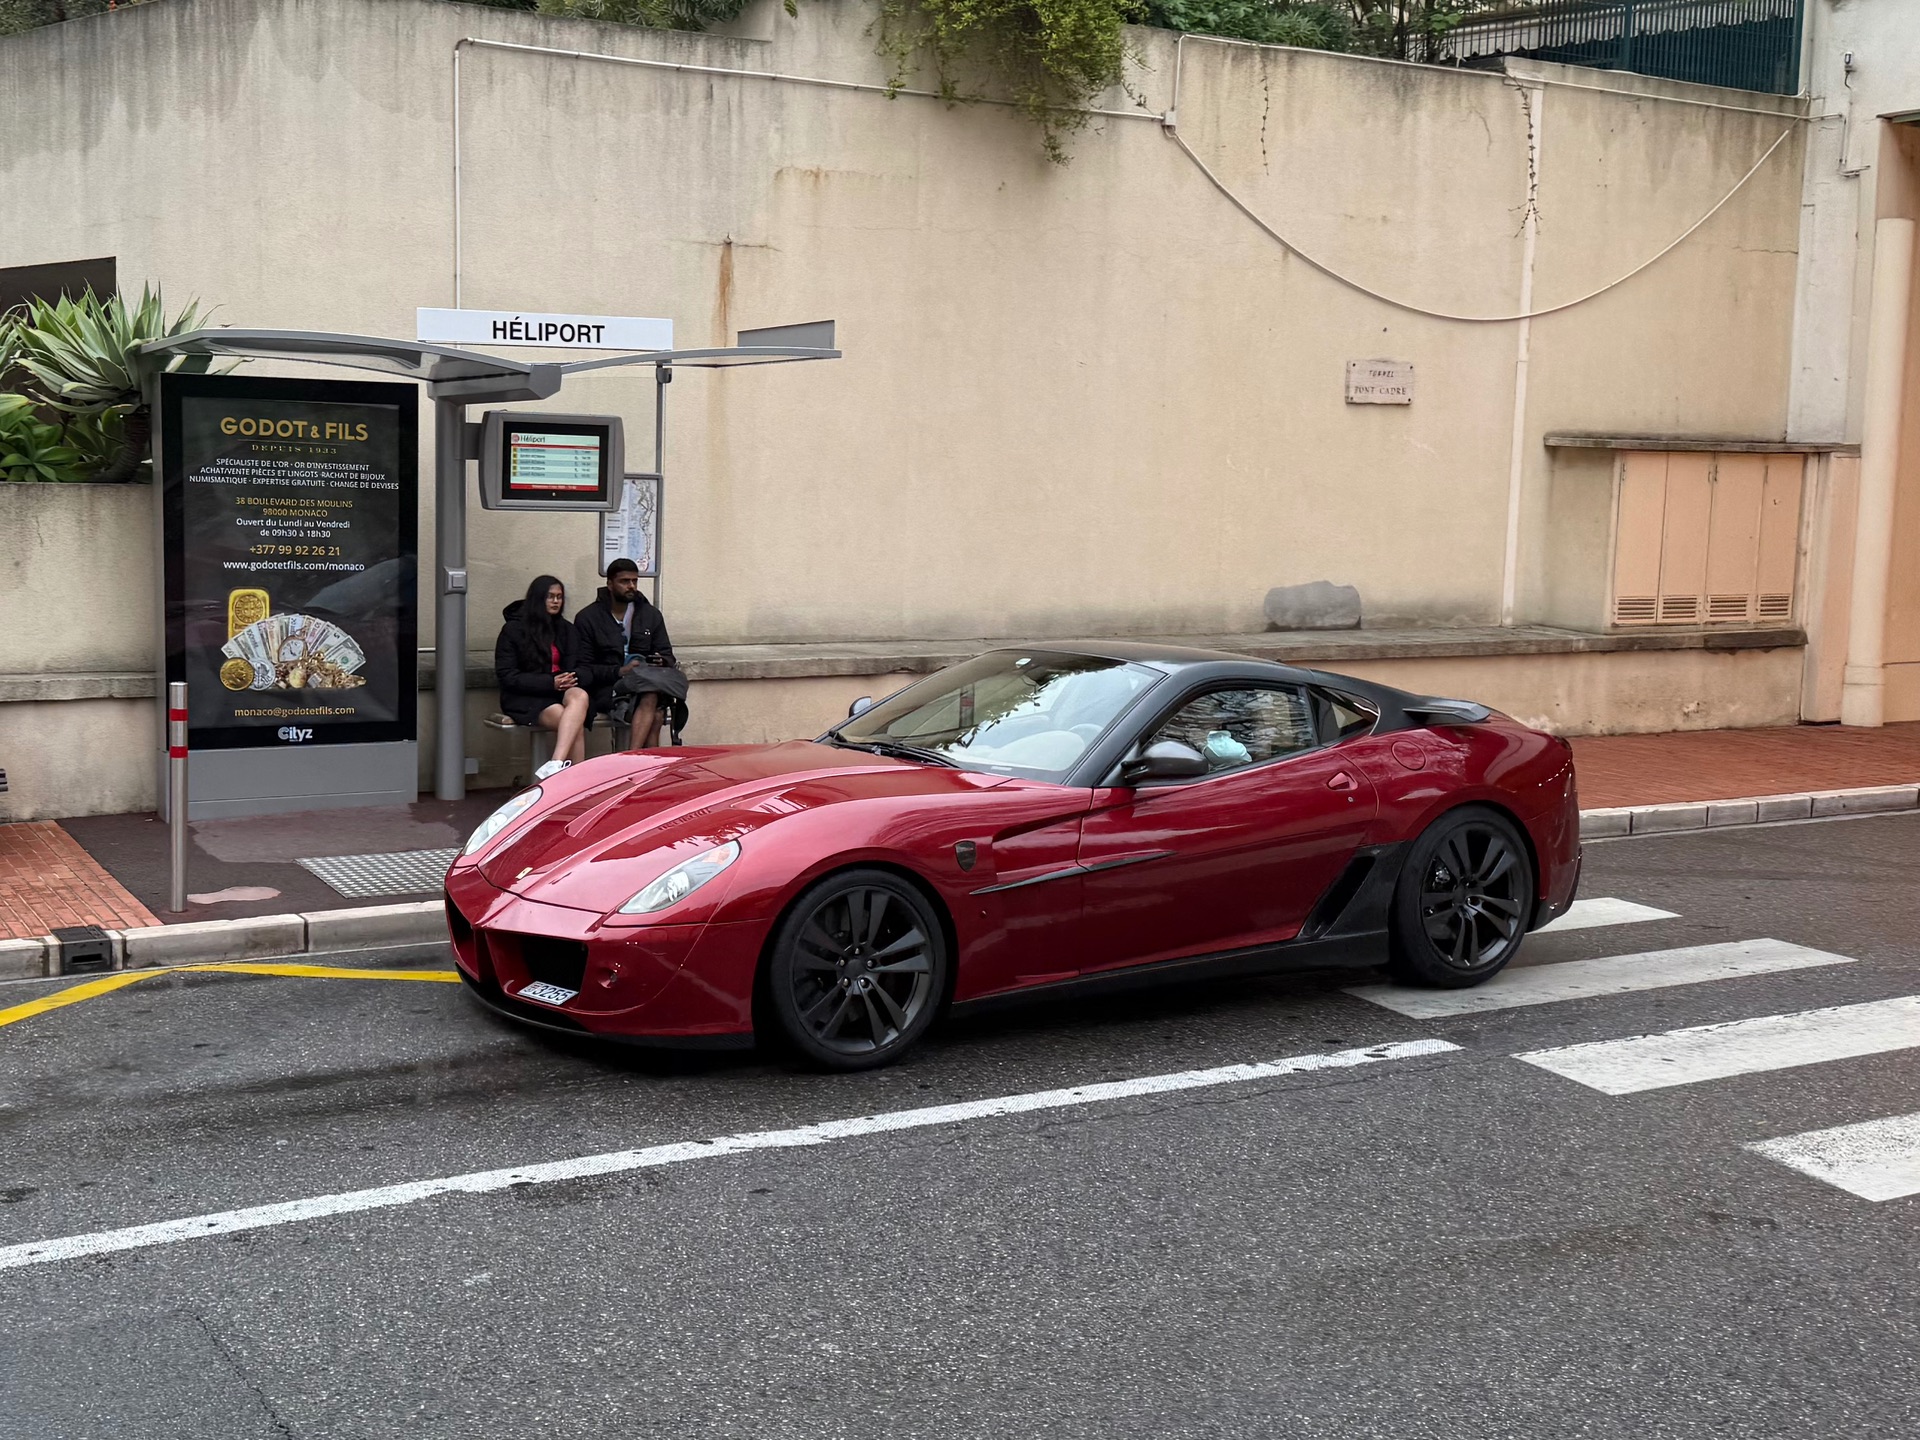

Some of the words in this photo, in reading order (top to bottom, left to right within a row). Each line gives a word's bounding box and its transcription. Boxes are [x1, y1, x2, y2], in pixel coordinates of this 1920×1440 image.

[492, 316, 605, 343] HÉLIPORT
[220, 416, 308, 438] GODOT
[310, 425, 320, 439] &
[325, 422, 369, 441] FILS
[252, 444, 301, 452] DEPUIS
[216, 458, 259, 467] SPÉCIALISTE
[294, 461, 305, 469] OR
[306, 462, 370, 471] D'INVESTISSEMENT
[200, 467, 250, 476] ACHAT/VENTE
[252, 467, 275, 477] PIÈCES
[287, 470, 319, 478] LINGOTS
[349, 472, 359, 480] DE
[360, 473, 386, 481] BIJOUX
[189, 475, 247, 484] NUMISMATIQUE
[252, 477, 290, 486] EXPERTISE
[291, 479, 325, 487] GRATUITE
[329, 480, 359, 489] CHANGE
[360, 481, 370, 489] DE
[371, 482, 399, 490] DEVISES
[235, 497, 245, 505] 38
[247, 497, 297, 506] BOULEVARD
[300, 499, 315, 507] DES
[317, 499, 353, 508] MOULINS
[262, 508, 288, 516] 98000
[289, 509, 328, 517] MONACO
[236, 518, 264, 527] Ouvert
[265, 518, 277, 527] du
[278, 519, 302, 527] Lundi
[316, 520, 350, 529] Vendredi
[260, 529, 270, 537] de
[271, 529, 297, 537] 09h30
[307, 530, 331, 538] 18h30
[249, 545, 276, 555] +377
[278, 545, 292, 555] 99
[295, 545, 309, 556] 92
[311, 546, 326, 556] 26
[328, 546, 341, 556] 21
[223, 560, 365, 572] www.godotetfils.com/monaco
[234, 706, 355, 718] monaco@godotetfils.com
[277, 726, 313, 741] Cityz
[532, 985, 573, 1001] 3255
